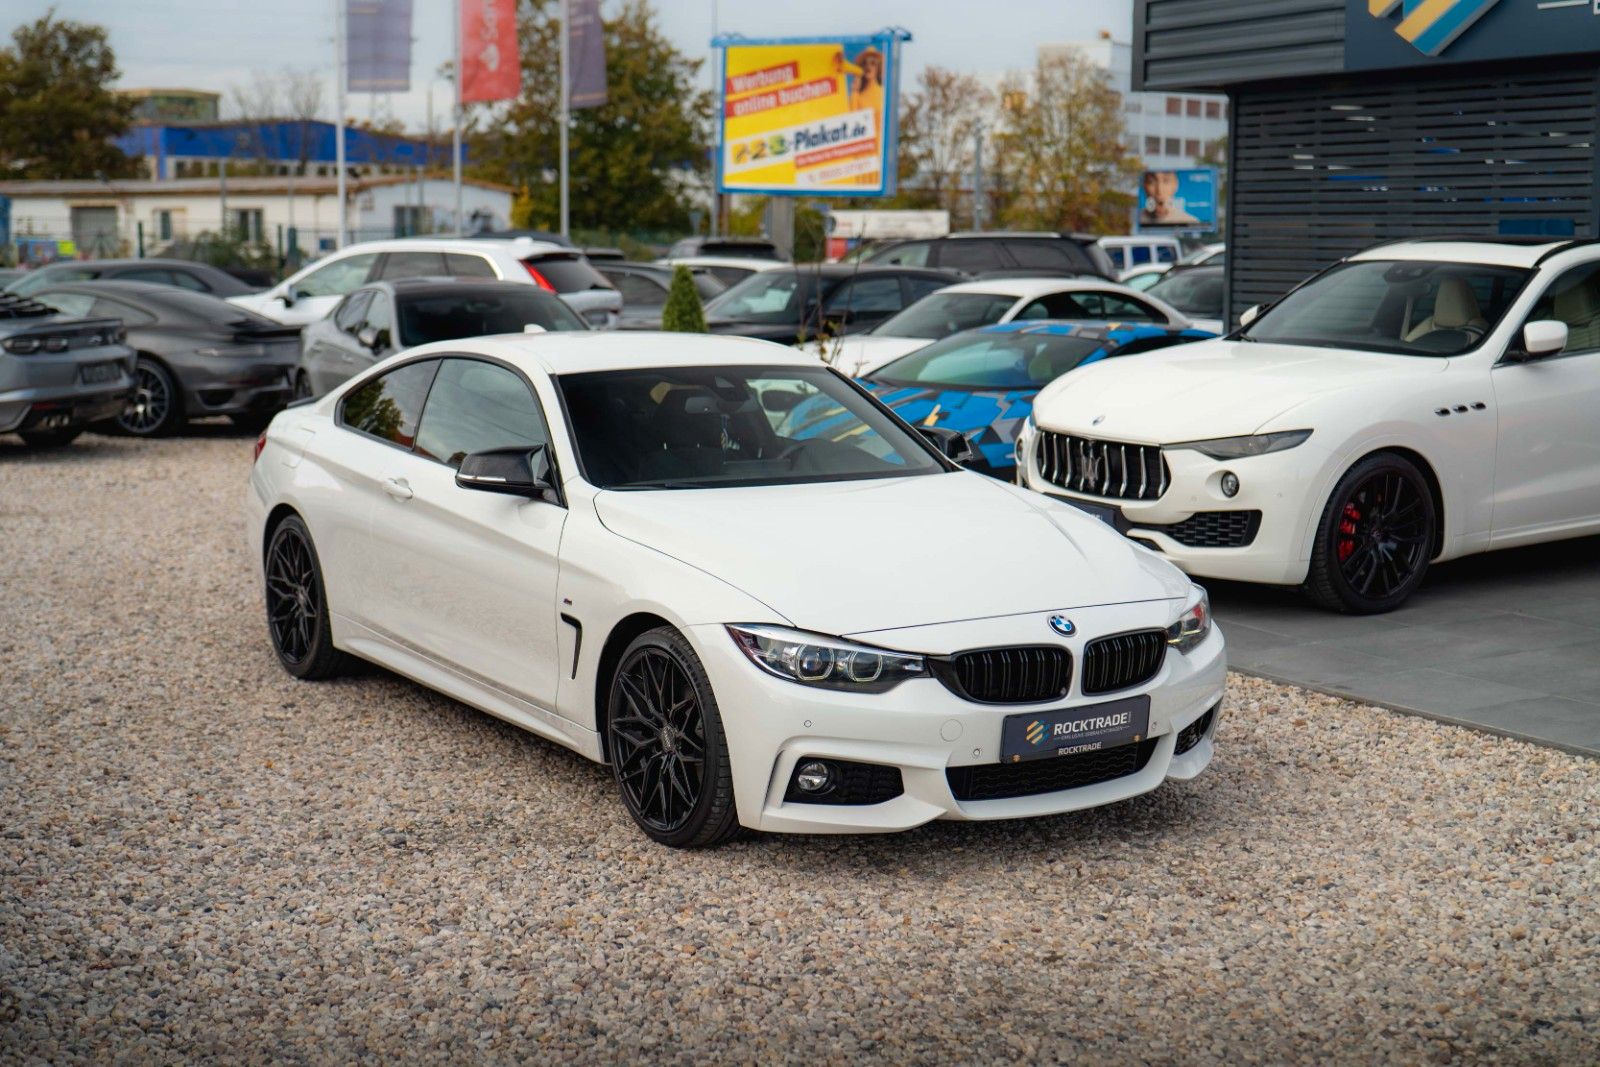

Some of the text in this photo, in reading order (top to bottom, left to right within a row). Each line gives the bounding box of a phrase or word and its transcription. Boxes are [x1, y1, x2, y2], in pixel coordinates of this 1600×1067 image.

[732, 65, 793, 92] Werbung
[734, 80, 831, 116] online buchen
[1053, 712, 1128, 736] ROCKTRADE
[1058, 741, 1102, 756] ROCKTRADE
